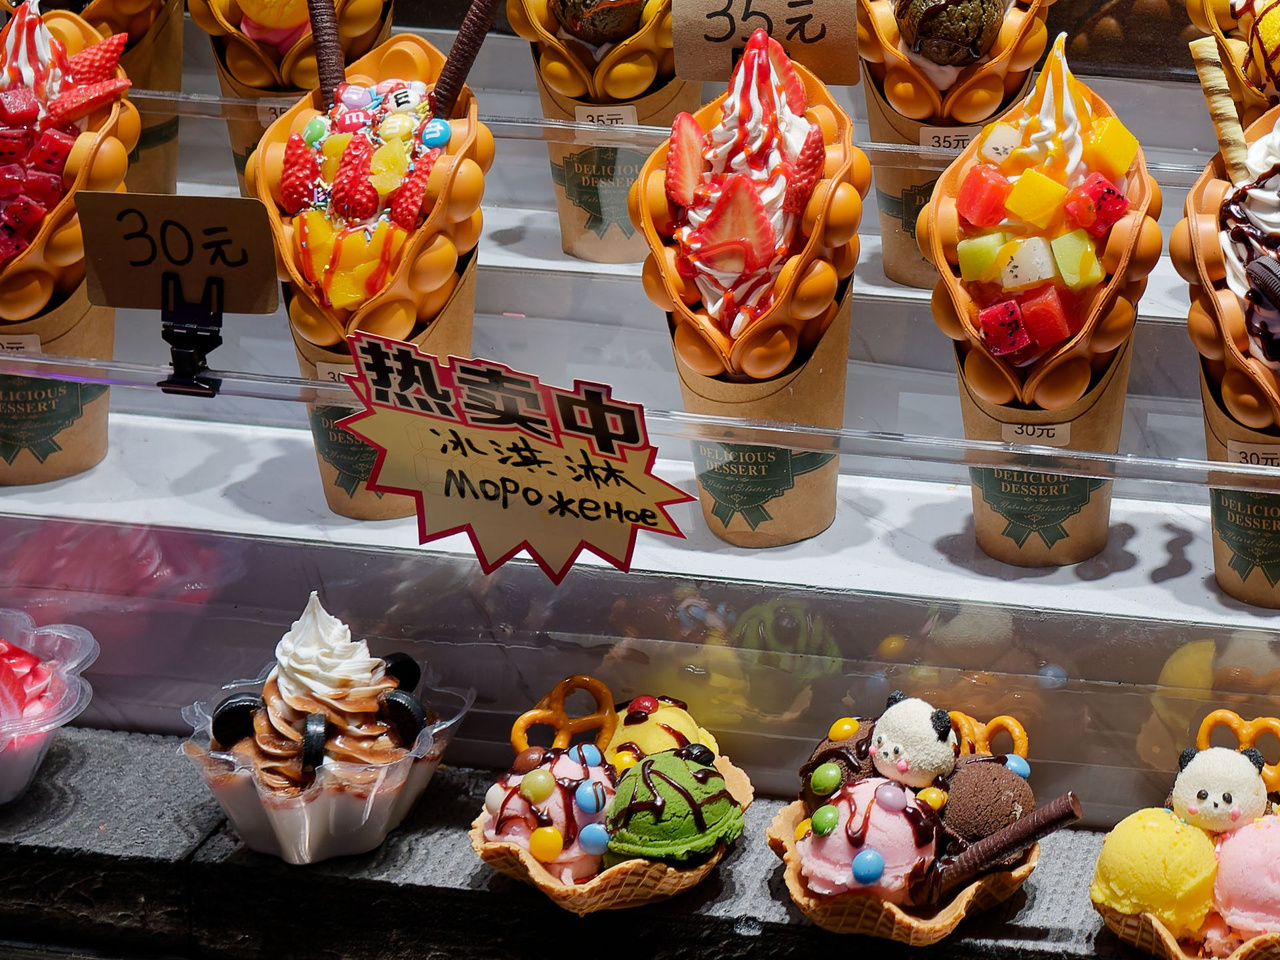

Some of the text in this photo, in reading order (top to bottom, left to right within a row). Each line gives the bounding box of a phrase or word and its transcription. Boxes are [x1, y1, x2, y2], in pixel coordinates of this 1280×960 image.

[931, 134, 970, 149] 35元
[116, 208, 248, 267] 30元
[0, 385, 67, 401] LICIOUS
[360, 341, 641, 455] 热卖中
[0, 400, 59, 414] ESSERT
[1015, 425, 1056, 438] 30元
[429, 428, 646, 494] 冰淇淋
[700, 445, 776, 462] DELICIOUS
[1239, 451, 1280, 467] 30元
[707, 461, 768, 476] DESSERT
[994, 469, 1076, 484] DELICIOU
[1002, 482, 1070, 496] DESSERT
[444, 468, 659, 527] Мороженое
